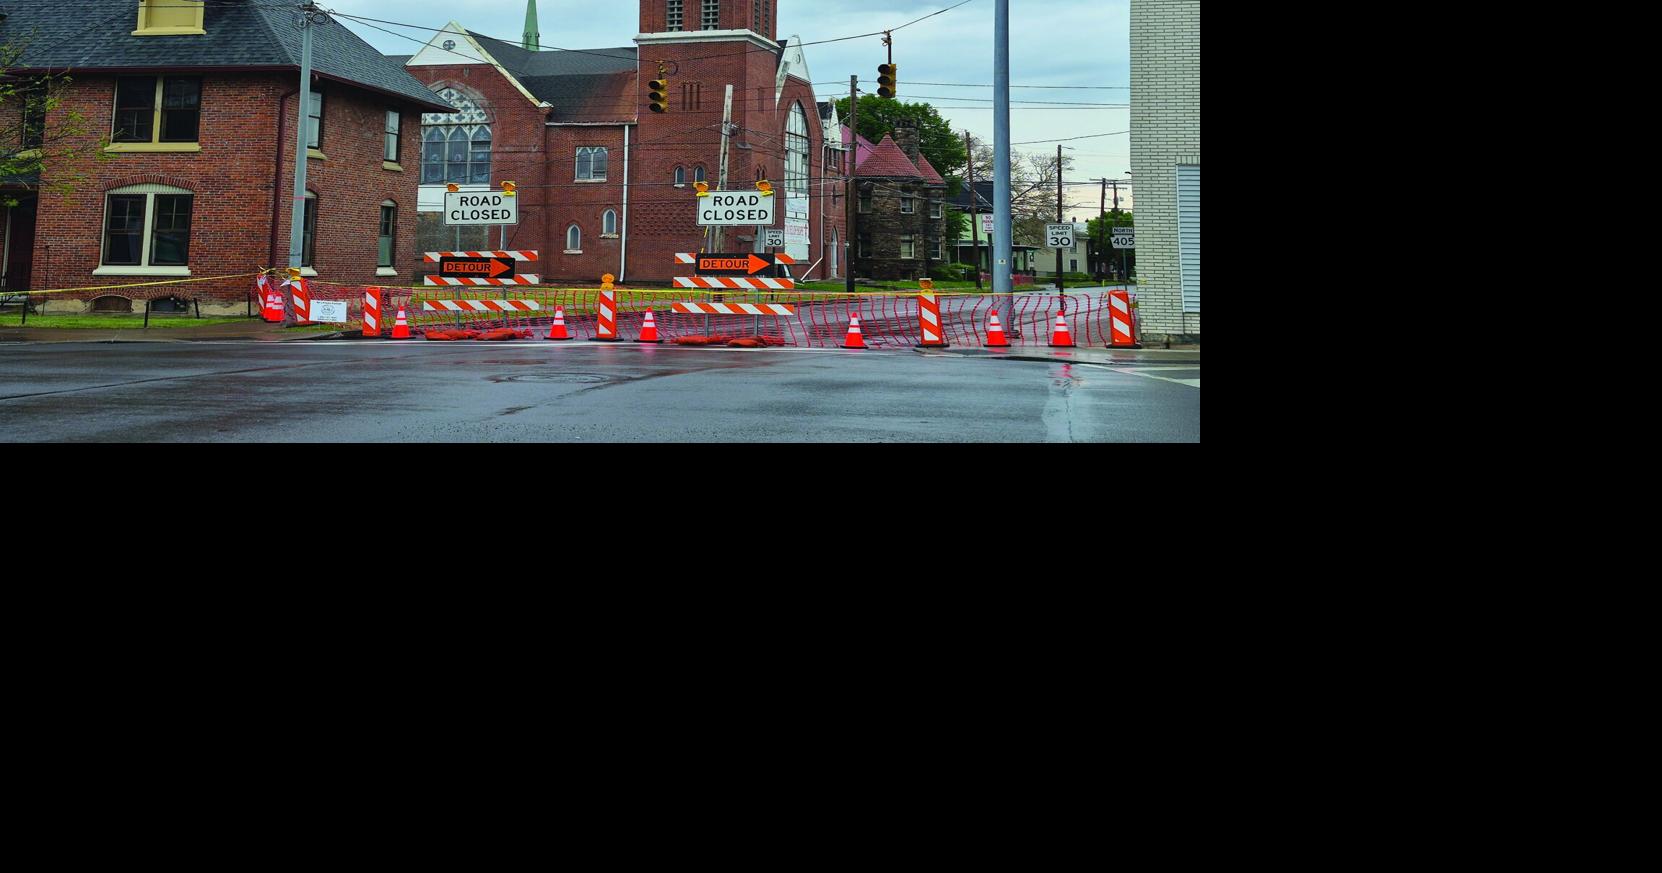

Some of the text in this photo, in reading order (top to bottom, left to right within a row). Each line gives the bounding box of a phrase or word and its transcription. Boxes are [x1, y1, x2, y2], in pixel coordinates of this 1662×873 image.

[460, 196, 502, 207] ROAD
[713, 195, 759, 207] ROAD
[451, 209, 511, 221] CLOSED
[703, 209, 768, 221] CLOSED
[1050, 237, 1071, 246] 30
[1113, 237, 1135, 246] 405
[446, 263, 491, 271] DETOUR
[703, 260, 750, 268] DETOUR
